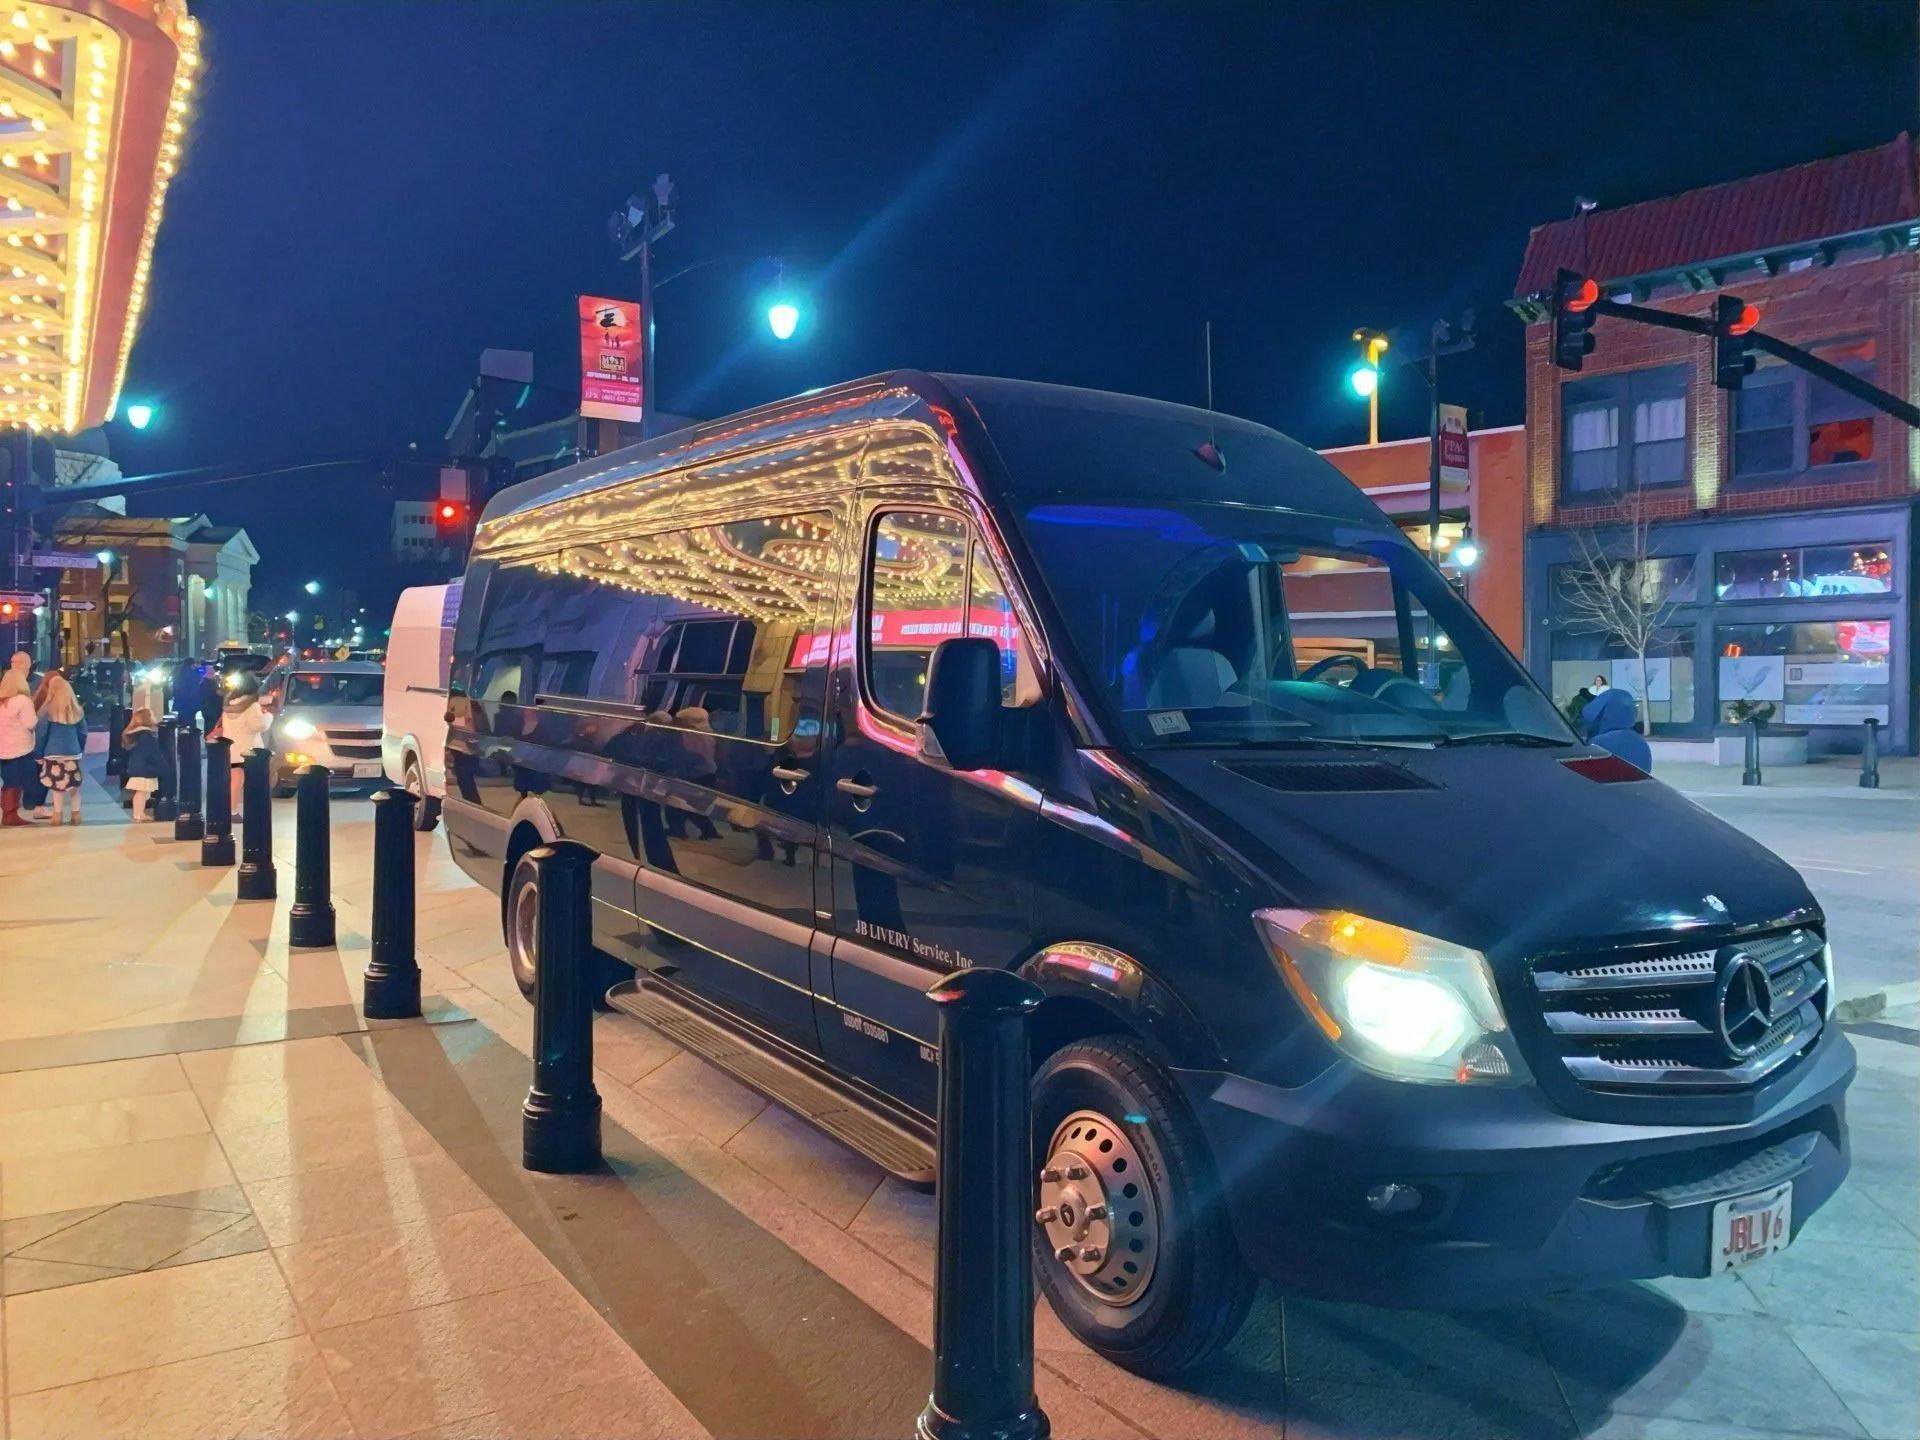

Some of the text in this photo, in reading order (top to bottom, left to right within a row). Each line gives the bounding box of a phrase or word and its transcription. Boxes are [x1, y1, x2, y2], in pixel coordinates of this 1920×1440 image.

[1444, 439, 1466, 455] PPAC
[855, 919, 868, 936] JB
[869, 923, 910, 950] LIVERY
[913, 937, 953, 967] Service,
